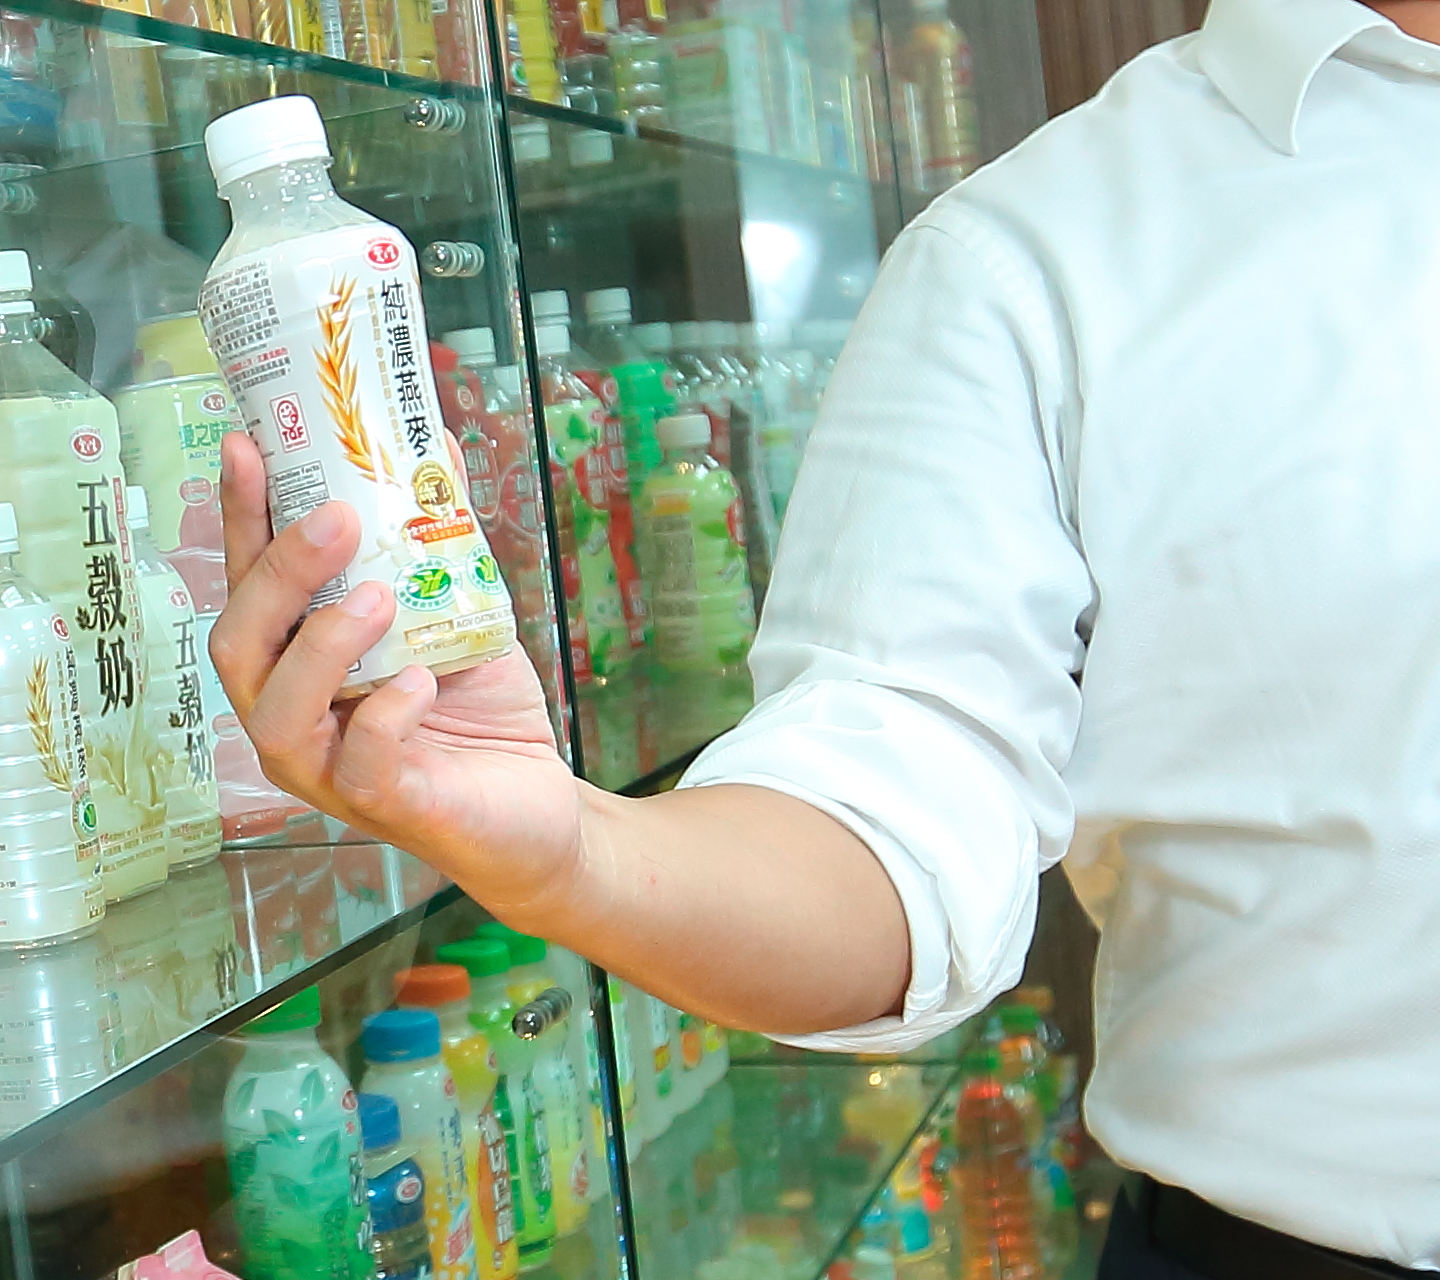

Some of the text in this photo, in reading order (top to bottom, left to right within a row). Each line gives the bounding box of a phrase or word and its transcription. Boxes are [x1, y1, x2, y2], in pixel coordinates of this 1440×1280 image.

[380, 276, 432, 459] 純濃燕麥
[77, 479, 134, 719] 五穀奶
